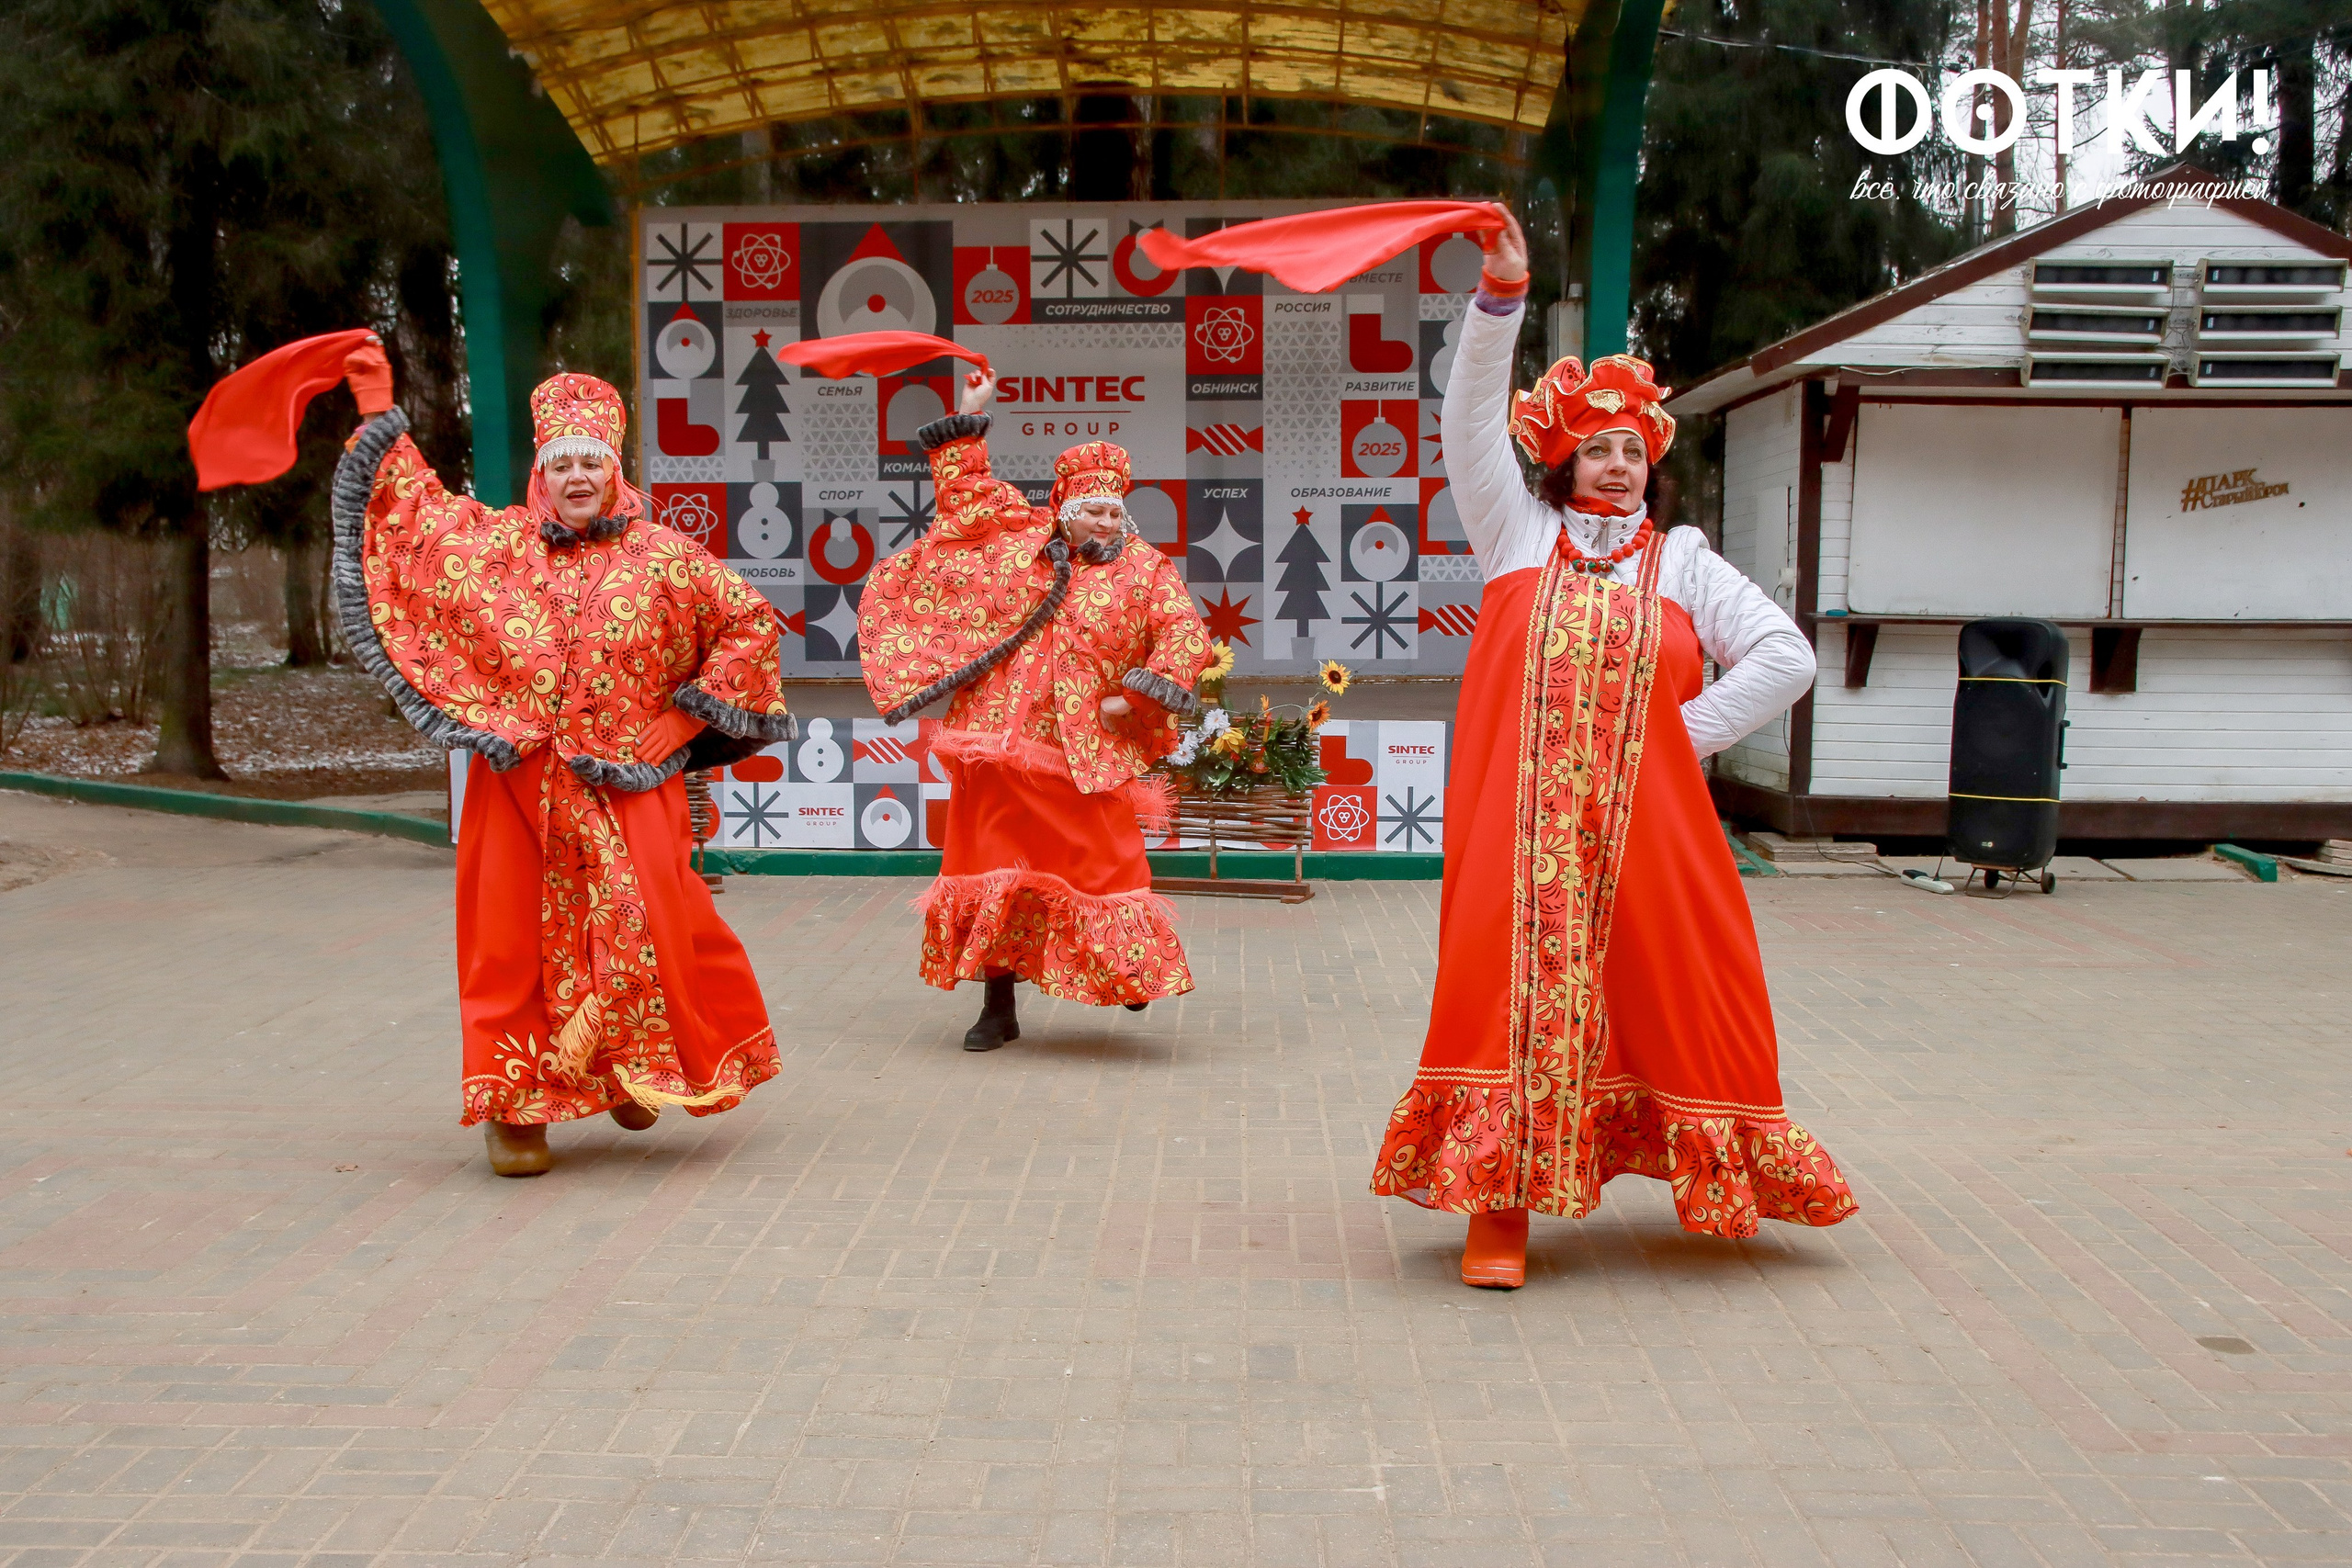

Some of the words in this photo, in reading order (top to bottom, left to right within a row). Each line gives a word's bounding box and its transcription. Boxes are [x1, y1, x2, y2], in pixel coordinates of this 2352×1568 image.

[1349, 272, 1404, 283] ВМЕСТЕ
[971, 289, 1014, 304] 2025
[1046, 303, 1171, 318] СОТРУДНИЧЕСТВО
[1274, 302, 1331, 313] РОССИЯ
[725, 307, 798, 320] ЗДОРОВЬЕ
[817, 386, 863, 397] СЕМЬЯ
[996, 376, 1146, 402] SINTEC
[1192, 382, 1259, 395] ОБНИНСК
[1345, 380, 1416, 393] РАЗВИТИЕ
[1022, 422, 1120, 436] GROUP
[1358, 442, 1402, 457] 2025
[883, 462, 932, 473] КОМАН
[819, 490, 864, 501] СПОРТ
[1203, 488, 1249, 499] УСПЕХ
[1291, 487, 1392, 498] ОБРАЗОВАНИЕ
[739, 568, 796, 578] ЛЮБОВЬ
[1388, 745, 1435, 754] SINTEC
[798, 807, 844, 816] SINTEC
